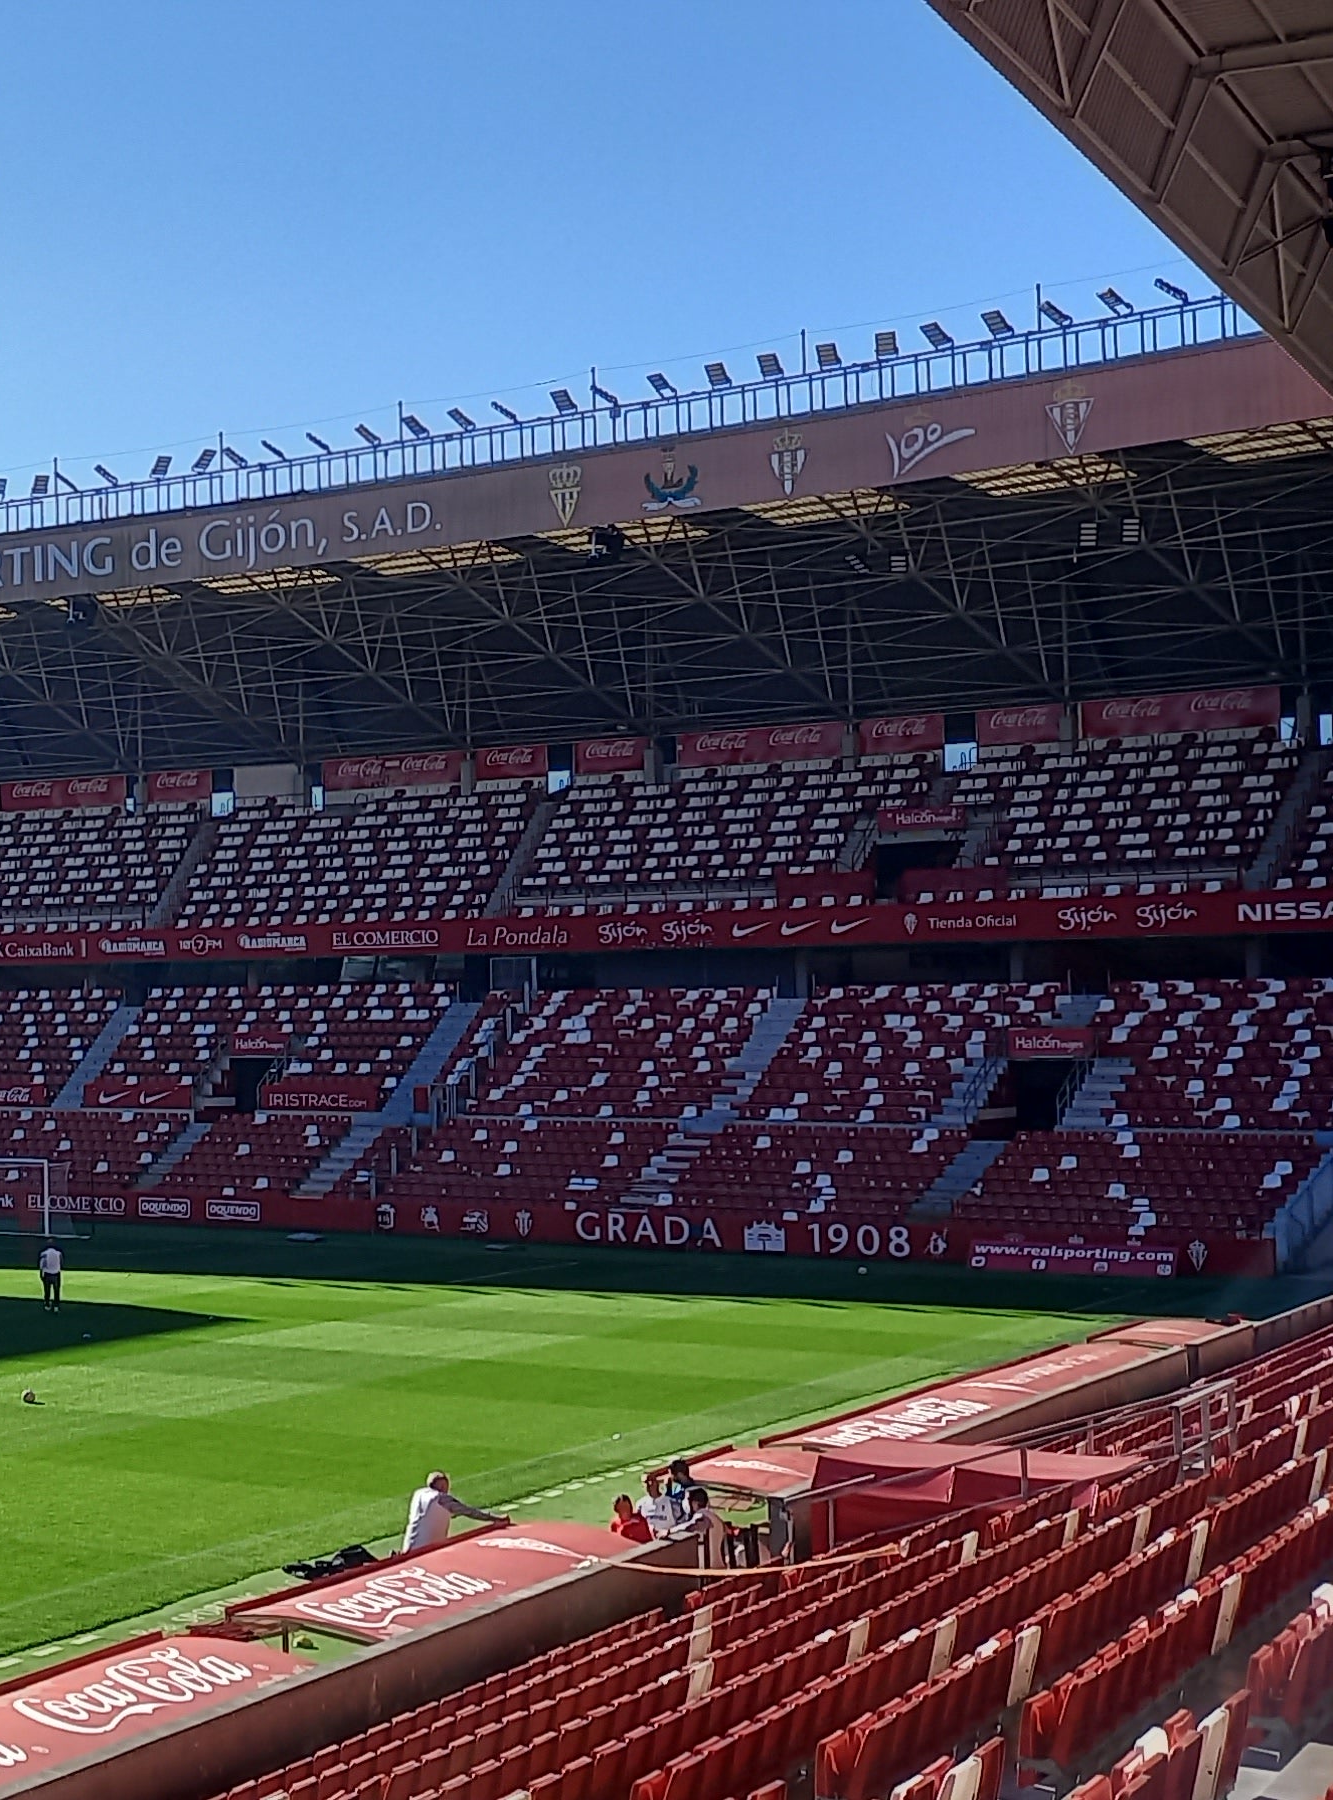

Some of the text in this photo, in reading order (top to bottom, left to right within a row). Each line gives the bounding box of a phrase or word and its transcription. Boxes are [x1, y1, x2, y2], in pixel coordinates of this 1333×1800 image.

[130, 534, 183, 570] de
[197, 507, 329, 570] Gijón,
[343, 500, 444, 541] S.A.D.
[1101, 698, 1161, 720] Coca-Cola
[1189, 691, 1251, 714] Coca-Cola
[870, 717, 927, 738] Coca-Cola
[989, 708, 1046, 730] Coca-Cola
[694, 731, 747, 752] Coca-Cola
[768, 725, 821, 746] Coca-Cola
[485, 747, 534, 767] Coca-Cola
[583, 739, 635, 759] Coca-Cola
[337, 759, 383, 778] Coca-Cola
[401, 754, 446, 773] Coca-Cola
[12, 782, 53, 799] Coca-Cola
[67, 779, 108, 795] Coca-Cola
[157, 775, 199, 791] Coca-Cola
[895, 809, 933, 825] Halcón
[927, 914, 1017, 929] Tienda Oficial
[1056, 904, 1118, 930] gijón
[1135, 901, 1198, 929] gijón
[331, 929, 439, 946] EL COMERCIO
[466, 925, 569, 946] La Pondala
[597, 922, 650, 944] gijón
[661, 918, 714, 943] gijón
[5, 942, 74, 958] CaixaBank
[235, 1036, 266, 1051] Halcón
[1015, 1035, 1060, 1052] Halcón
[141, 1201, 187, 1215] OQUENDO
[209, 1204, 257, 1218] OQUENDO
[575, 1211, 911, 1257] GRADA 1908
[975, 1242, 1174, 1266] www.realsporting.com
[295, 1566, 492, 1629] Coca-Cola
[13, 1645, 253, 1735] Coca-Cola
